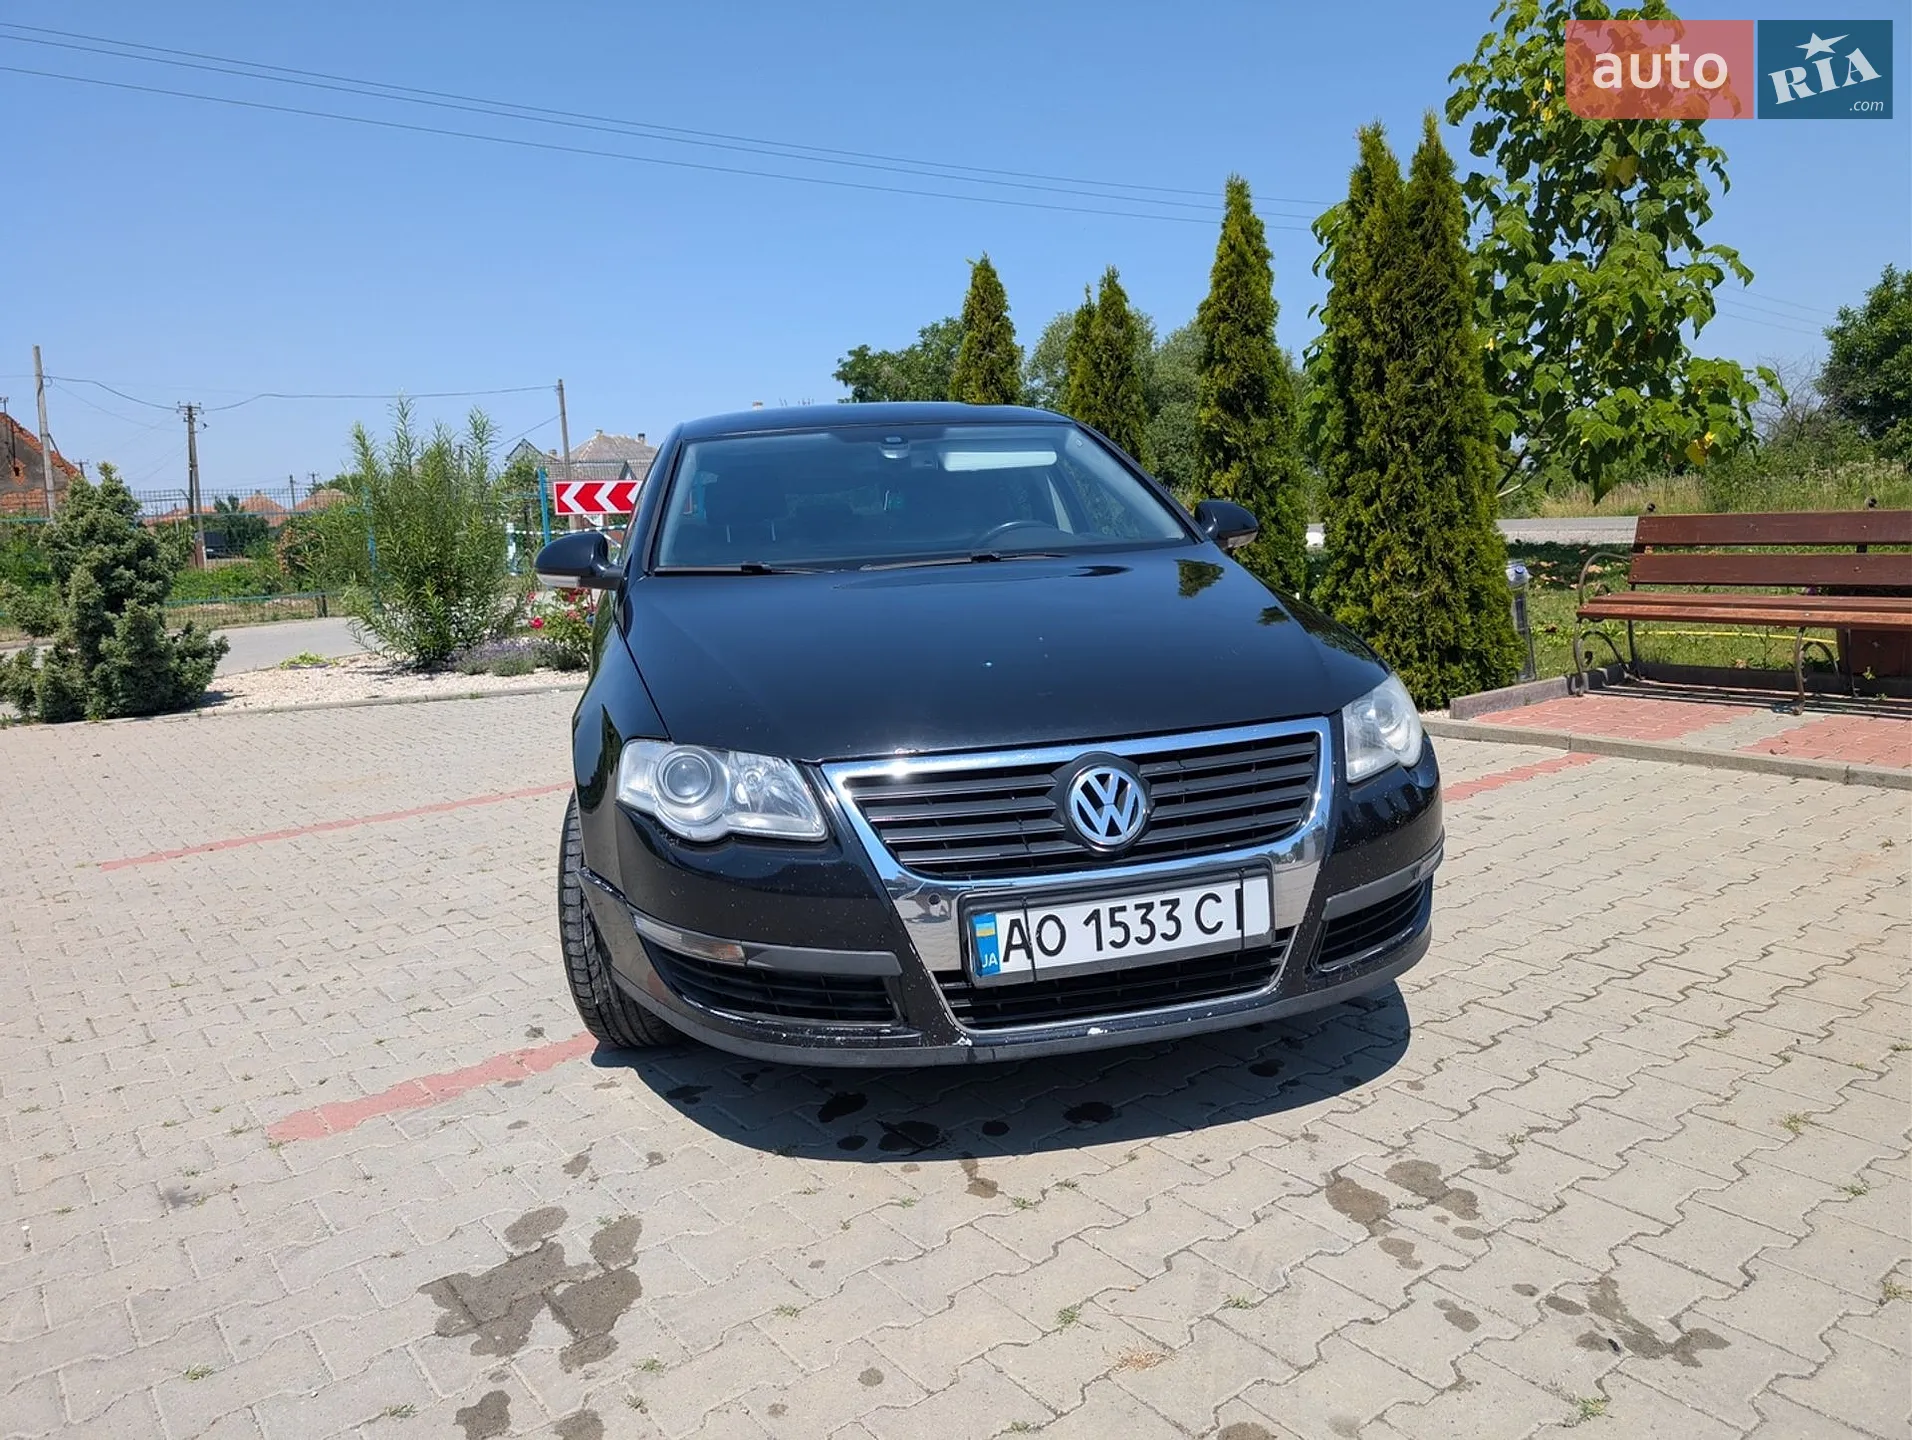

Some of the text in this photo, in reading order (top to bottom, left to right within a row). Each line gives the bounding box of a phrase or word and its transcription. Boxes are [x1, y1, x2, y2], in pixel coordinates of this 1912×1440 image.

[1002, 888, 1242, 963] AO 1533 CI
